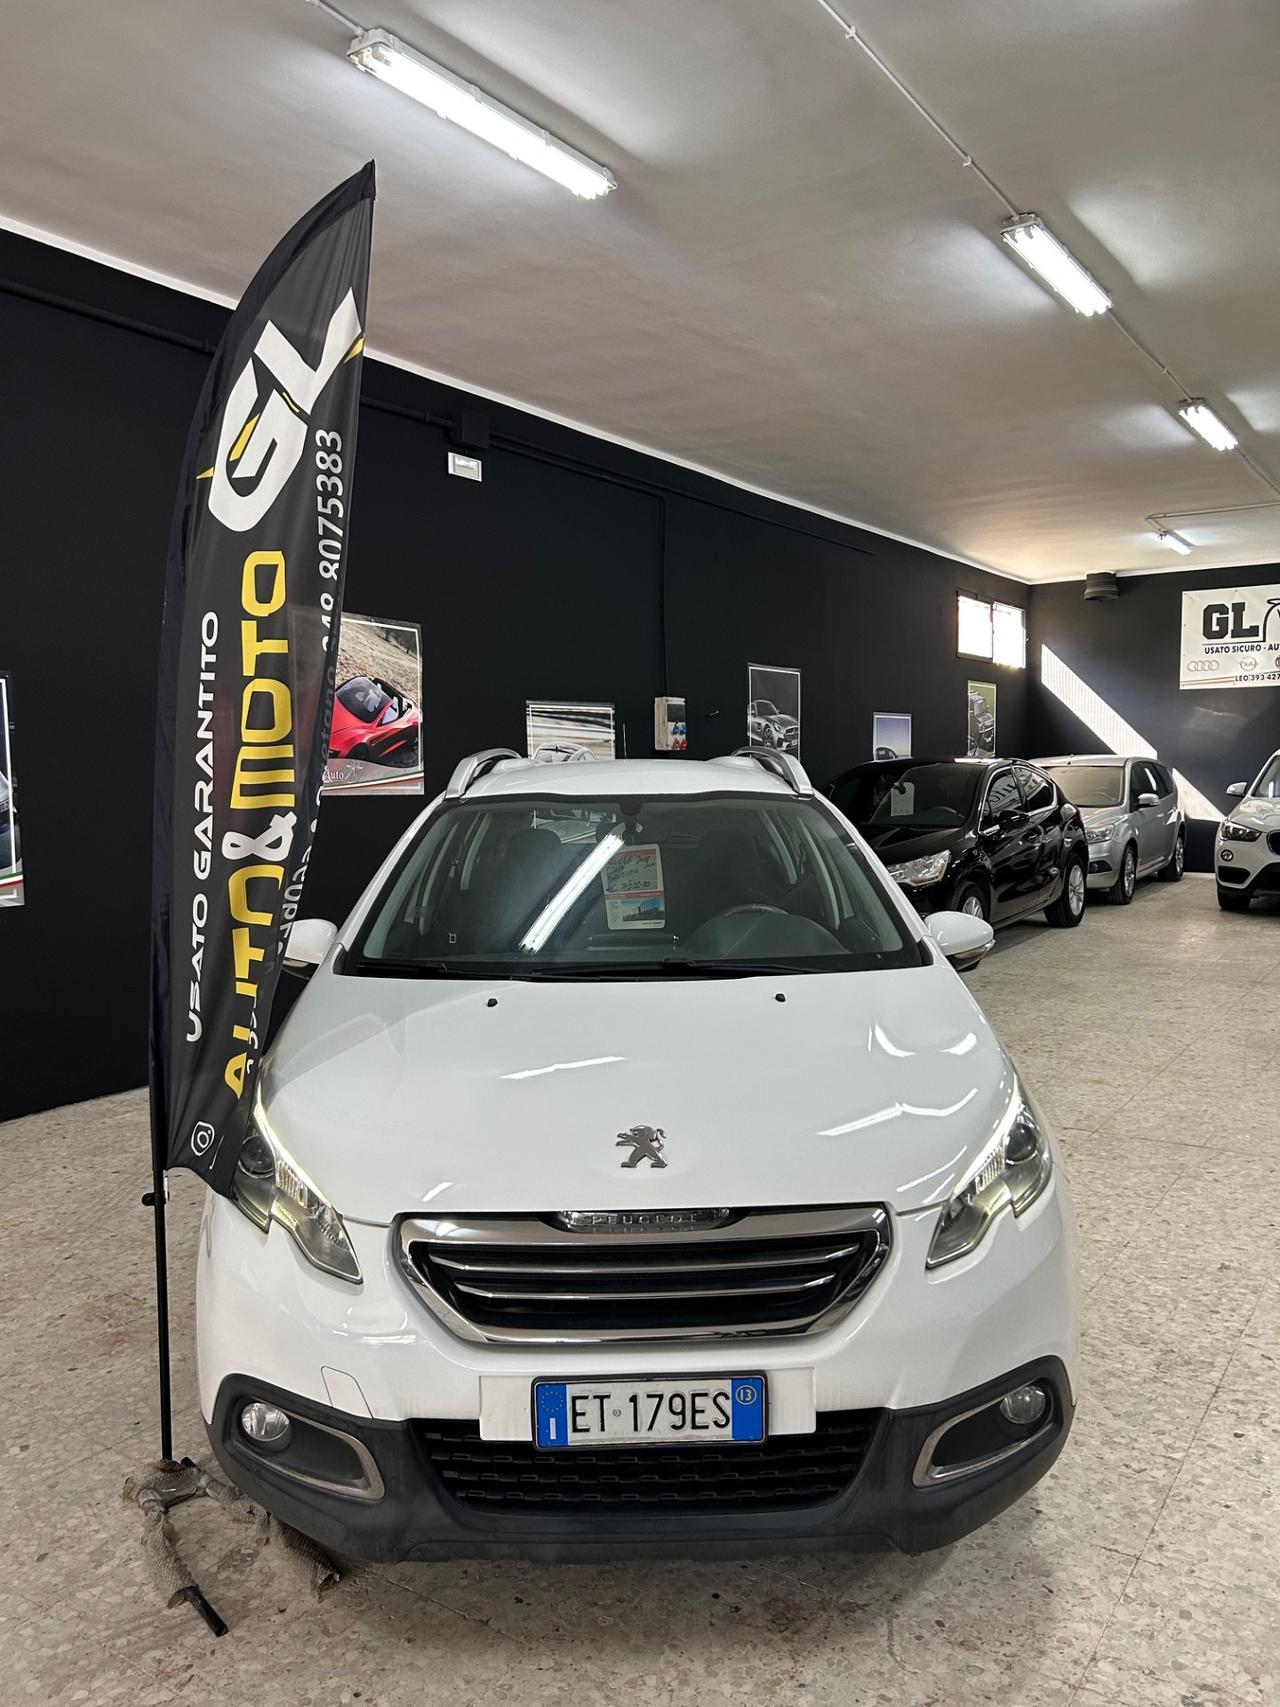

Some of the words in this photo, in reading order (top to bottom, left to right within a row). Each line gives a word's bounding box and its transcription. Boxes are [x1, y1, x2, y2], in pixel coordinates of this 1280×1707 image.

[208, 286, 362, 532] GL
[315, 429, 344, 581] 8075383
[1203, 602, 1260, 639] GL
[1204, 645, 1230, 655] USATO
[1231, 645, 1261, 653] SICURO
[193, 611, 219, 880] GARANTITO
[186, 893, 208, 1042] USATO
[592, 1212, 697, 1225] PEUGEOT
[571, 1394, 611, 1433] ET
[628, 1391, 731, 1432] 179ES
[739, 1388, 753, 1402] 13
